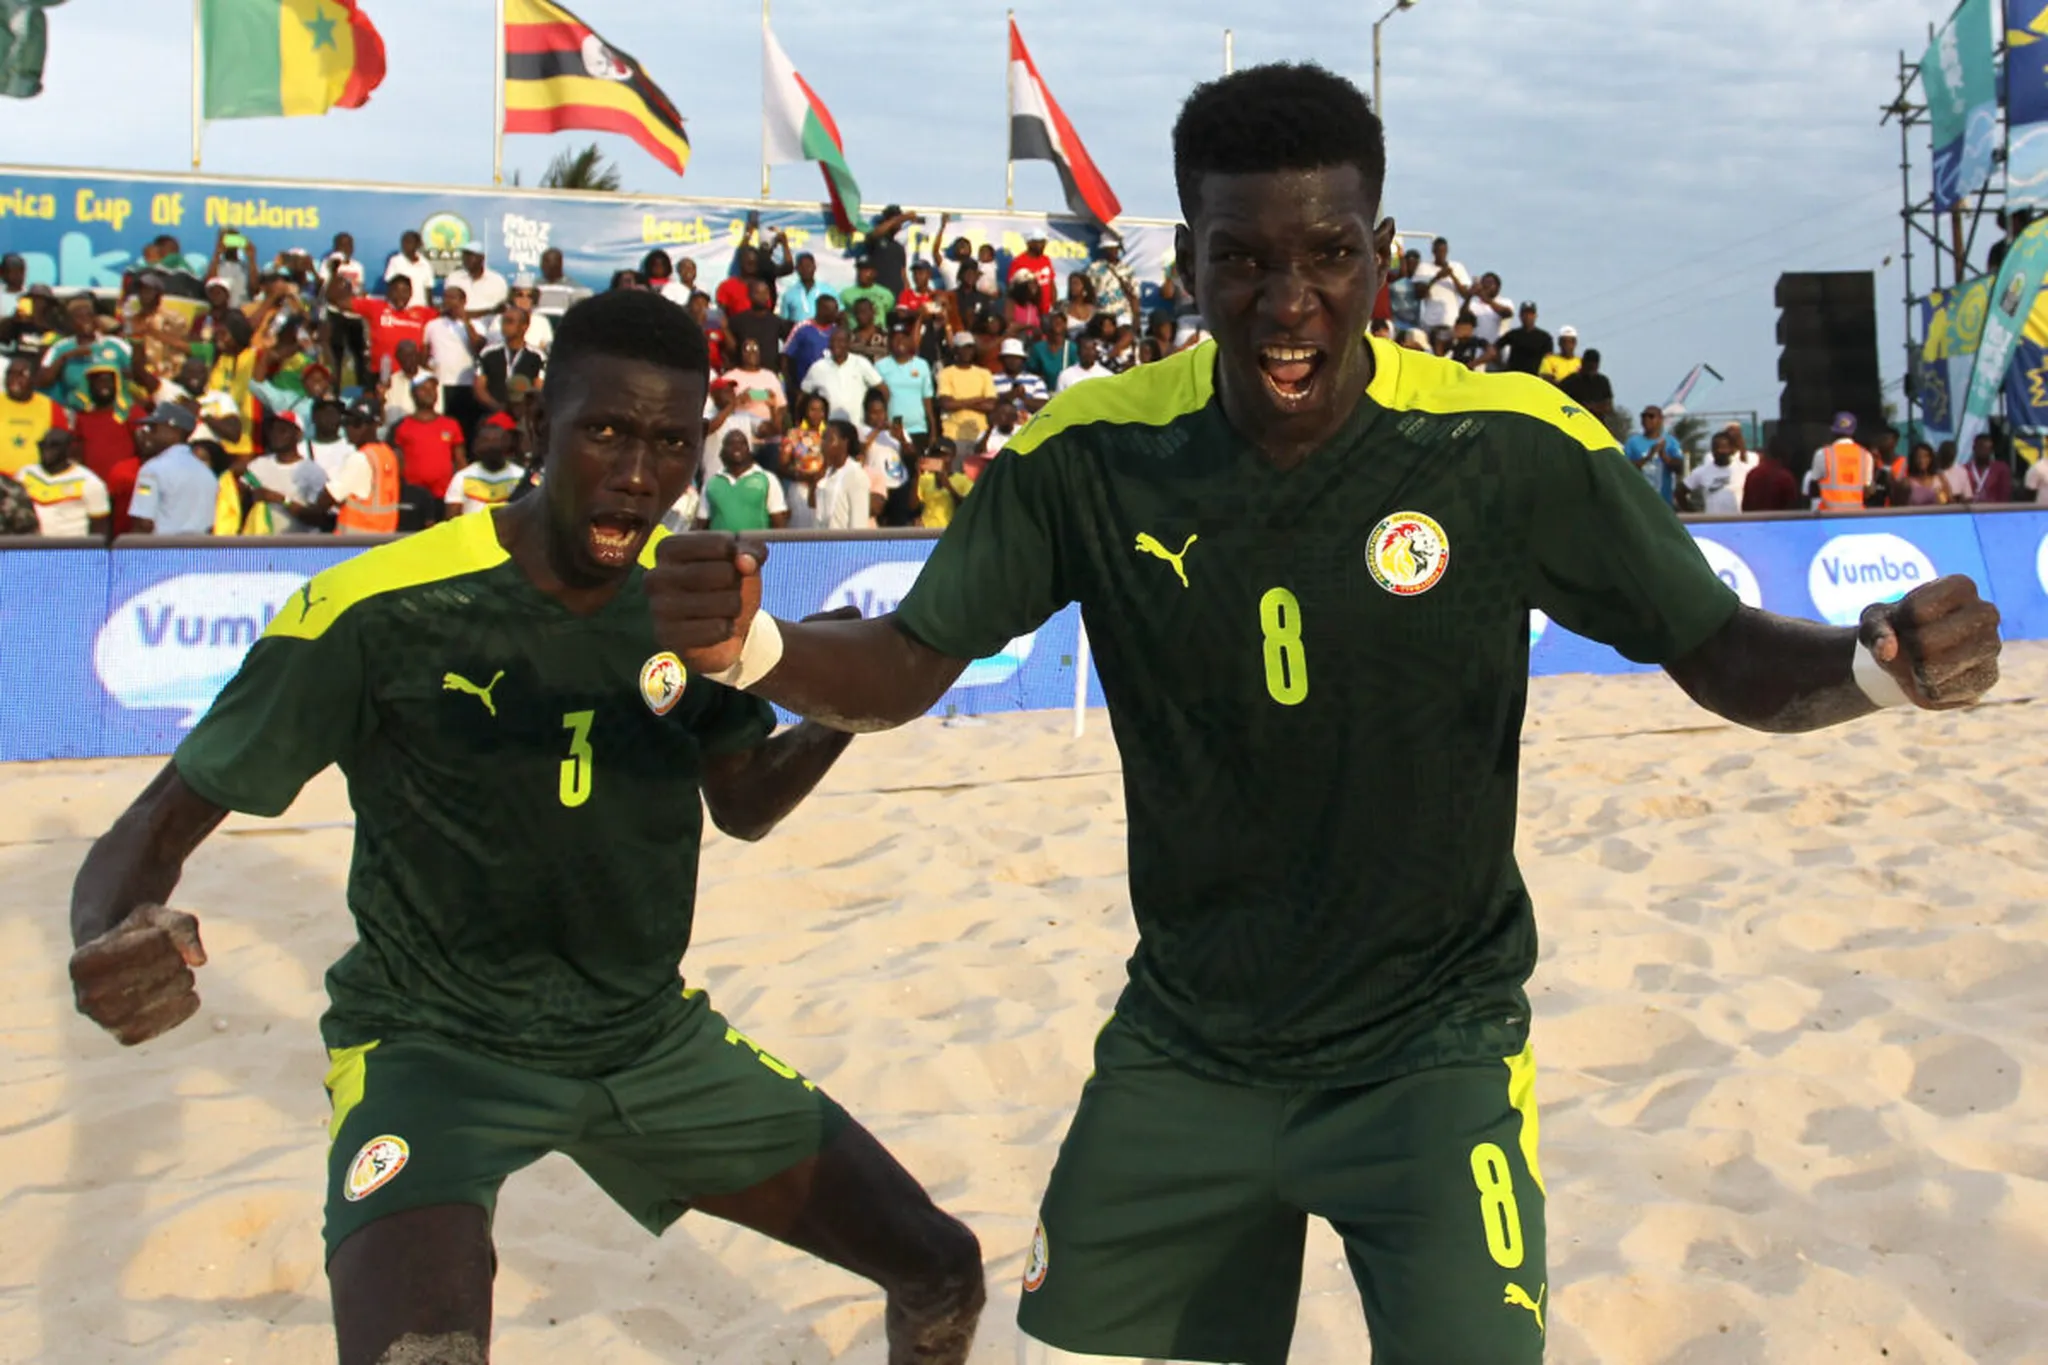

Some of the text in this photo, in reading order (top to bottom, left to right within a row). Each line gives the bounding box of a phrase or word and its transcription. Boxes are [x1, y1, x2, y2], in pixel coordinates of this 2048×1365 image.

[75, 188, 131, 232] Cup
[204, 195, 319, 229] Nations
[1822, 556, 1920, 587] Vumba
[136, 602, 275, 647] Vum
[1259, 586, 1309, 706] 8
[559, 709, 595, 808] 3
[1470, 1142, 1524, 1268] 8
